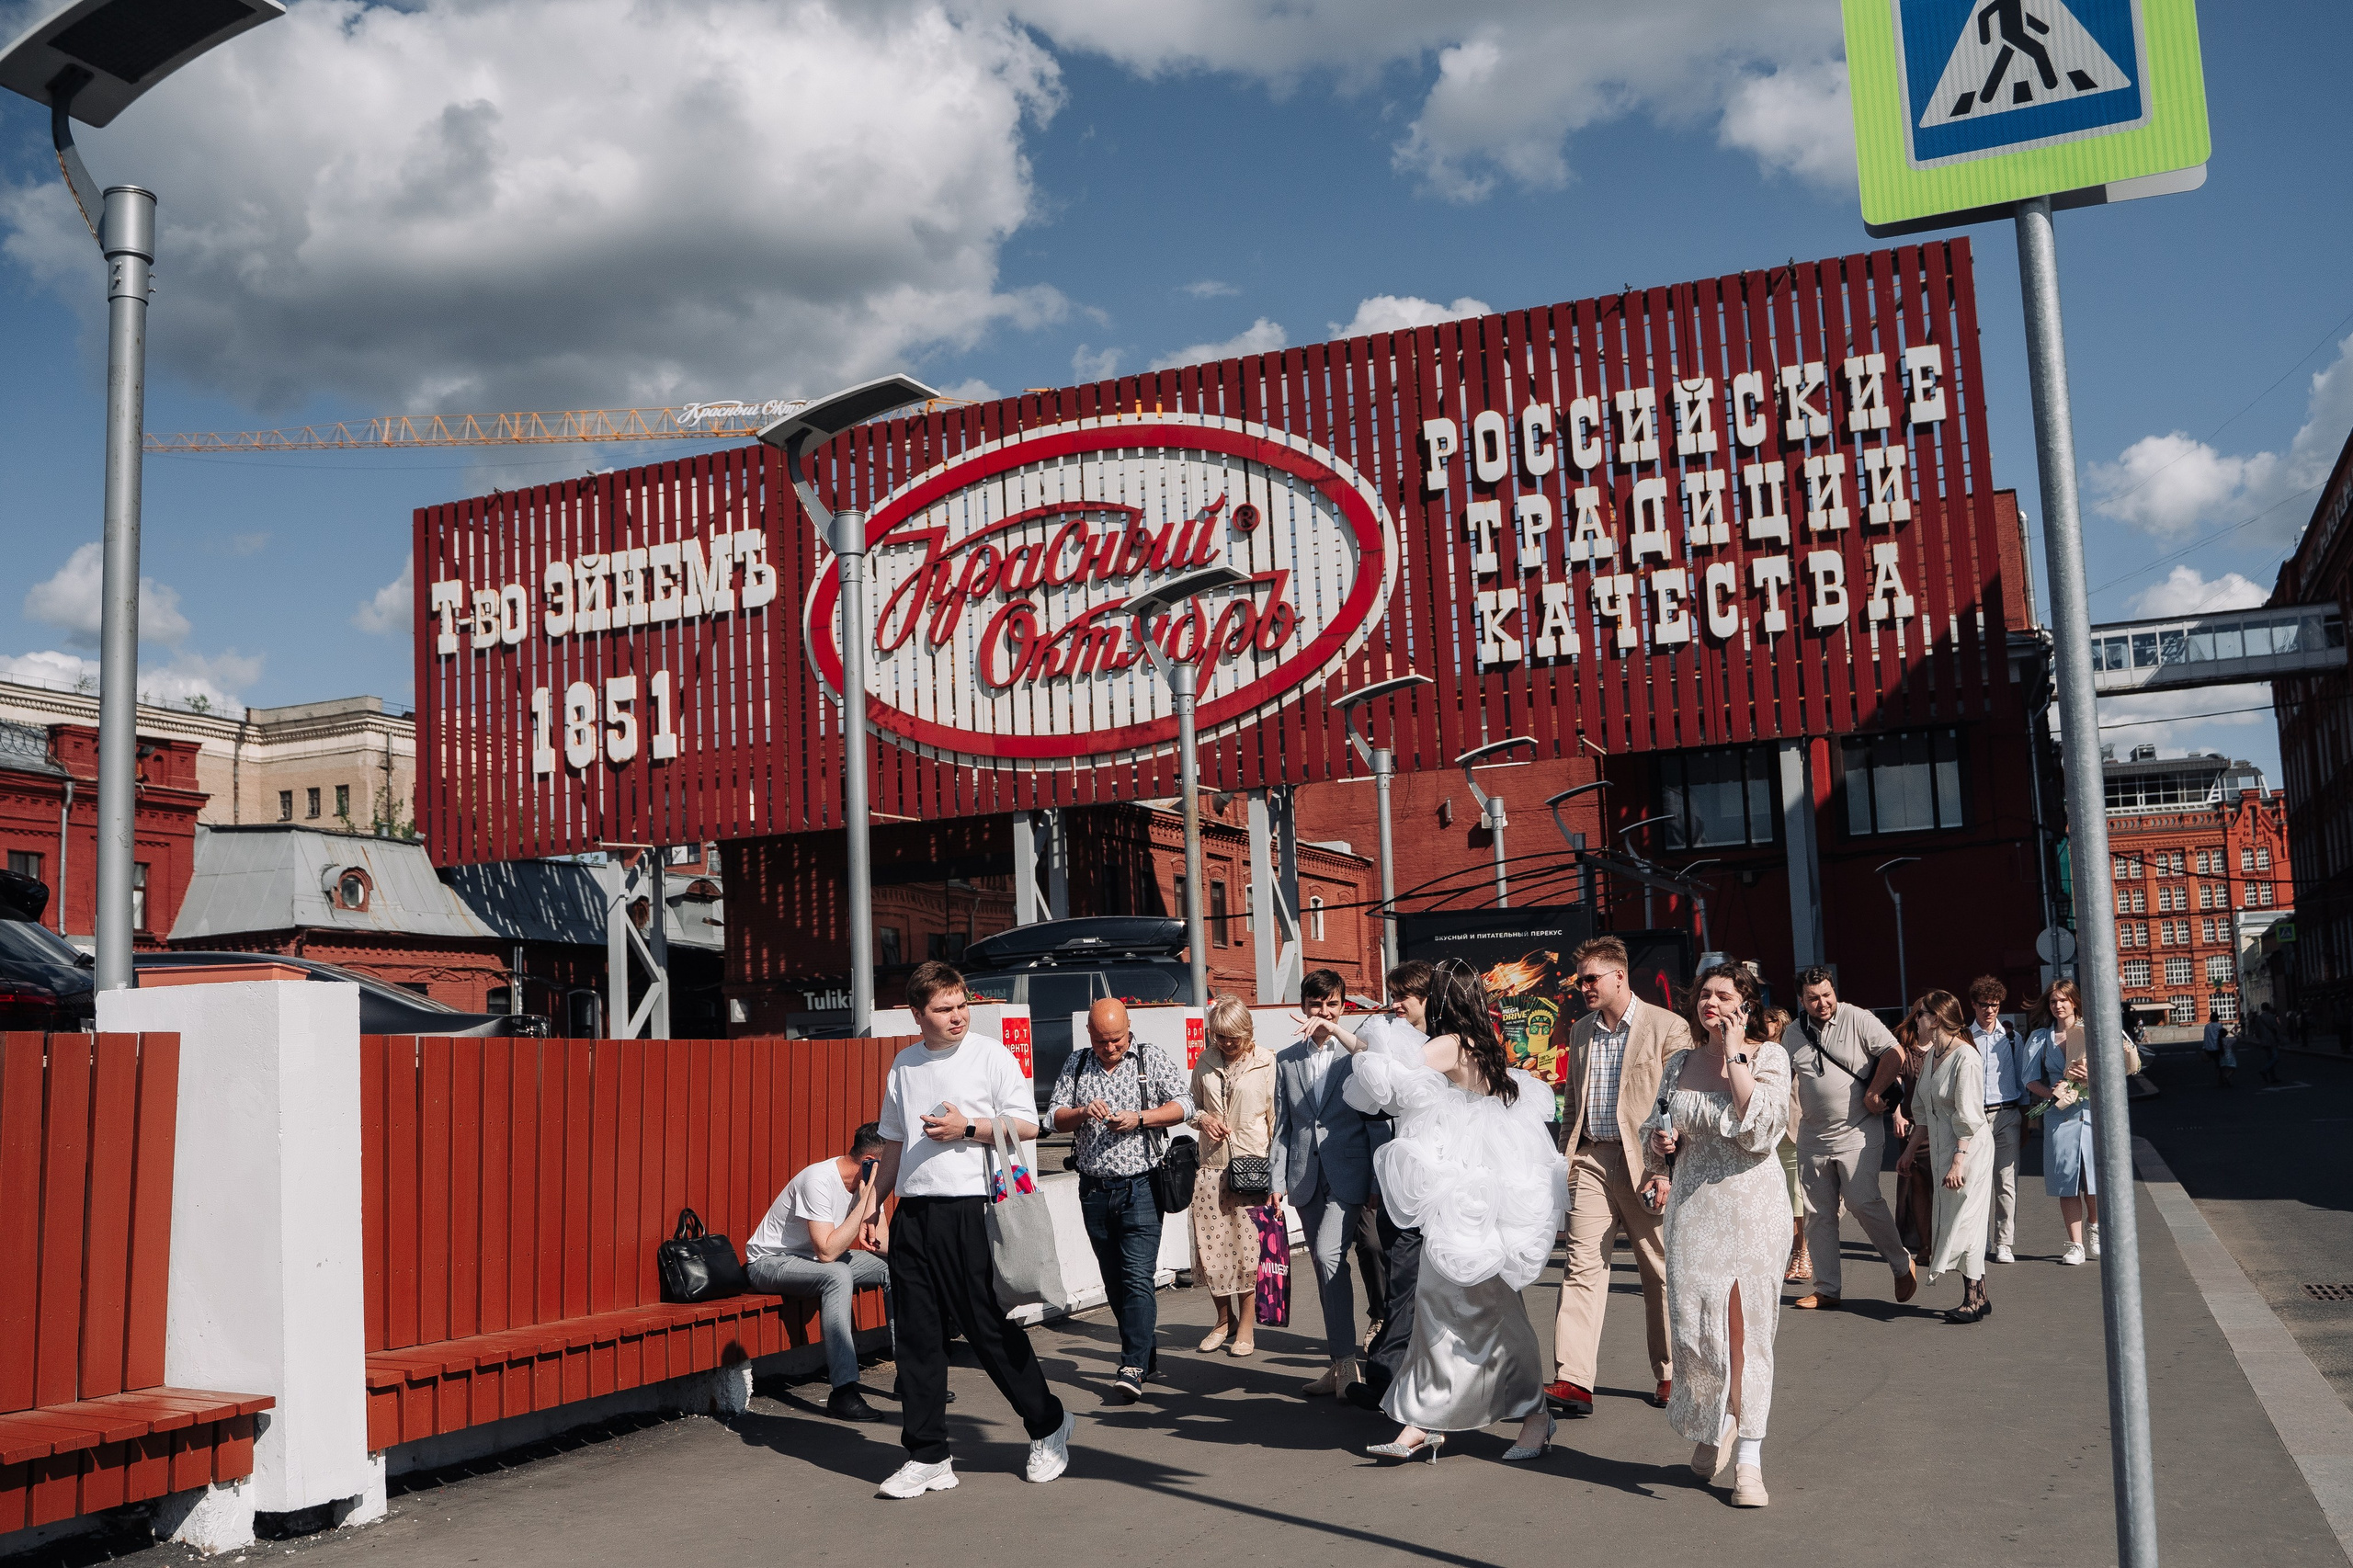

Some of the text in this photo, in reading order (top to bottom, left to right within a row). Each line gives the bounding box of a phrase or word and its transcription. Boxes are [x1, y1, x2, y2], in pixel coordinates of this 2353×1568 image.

[1424, 344, 1947, 491] РОССИЙСКИЕ
[1467, 445, 1911, 574] ТРАДИЦИИ
[431, 528, 777, 654] Т-ВО ЭЙНЕМЪ
[875, 492, 1226, 653] Красный
[1476, 542, 1915, 665] КАЧЕСТВА
[530, 670, 678, 774] 1851
[1476, 931, 1529, 939] ПИТАТЕЛЬНЫЙ
[1005, 1028, 1028, 1041] арт
[1187, 1028, 1203, 1038] арт
[1502, 1006, 1519, 1015] MEGA
[1503, 1010, 1528, 1022] DRIVE
